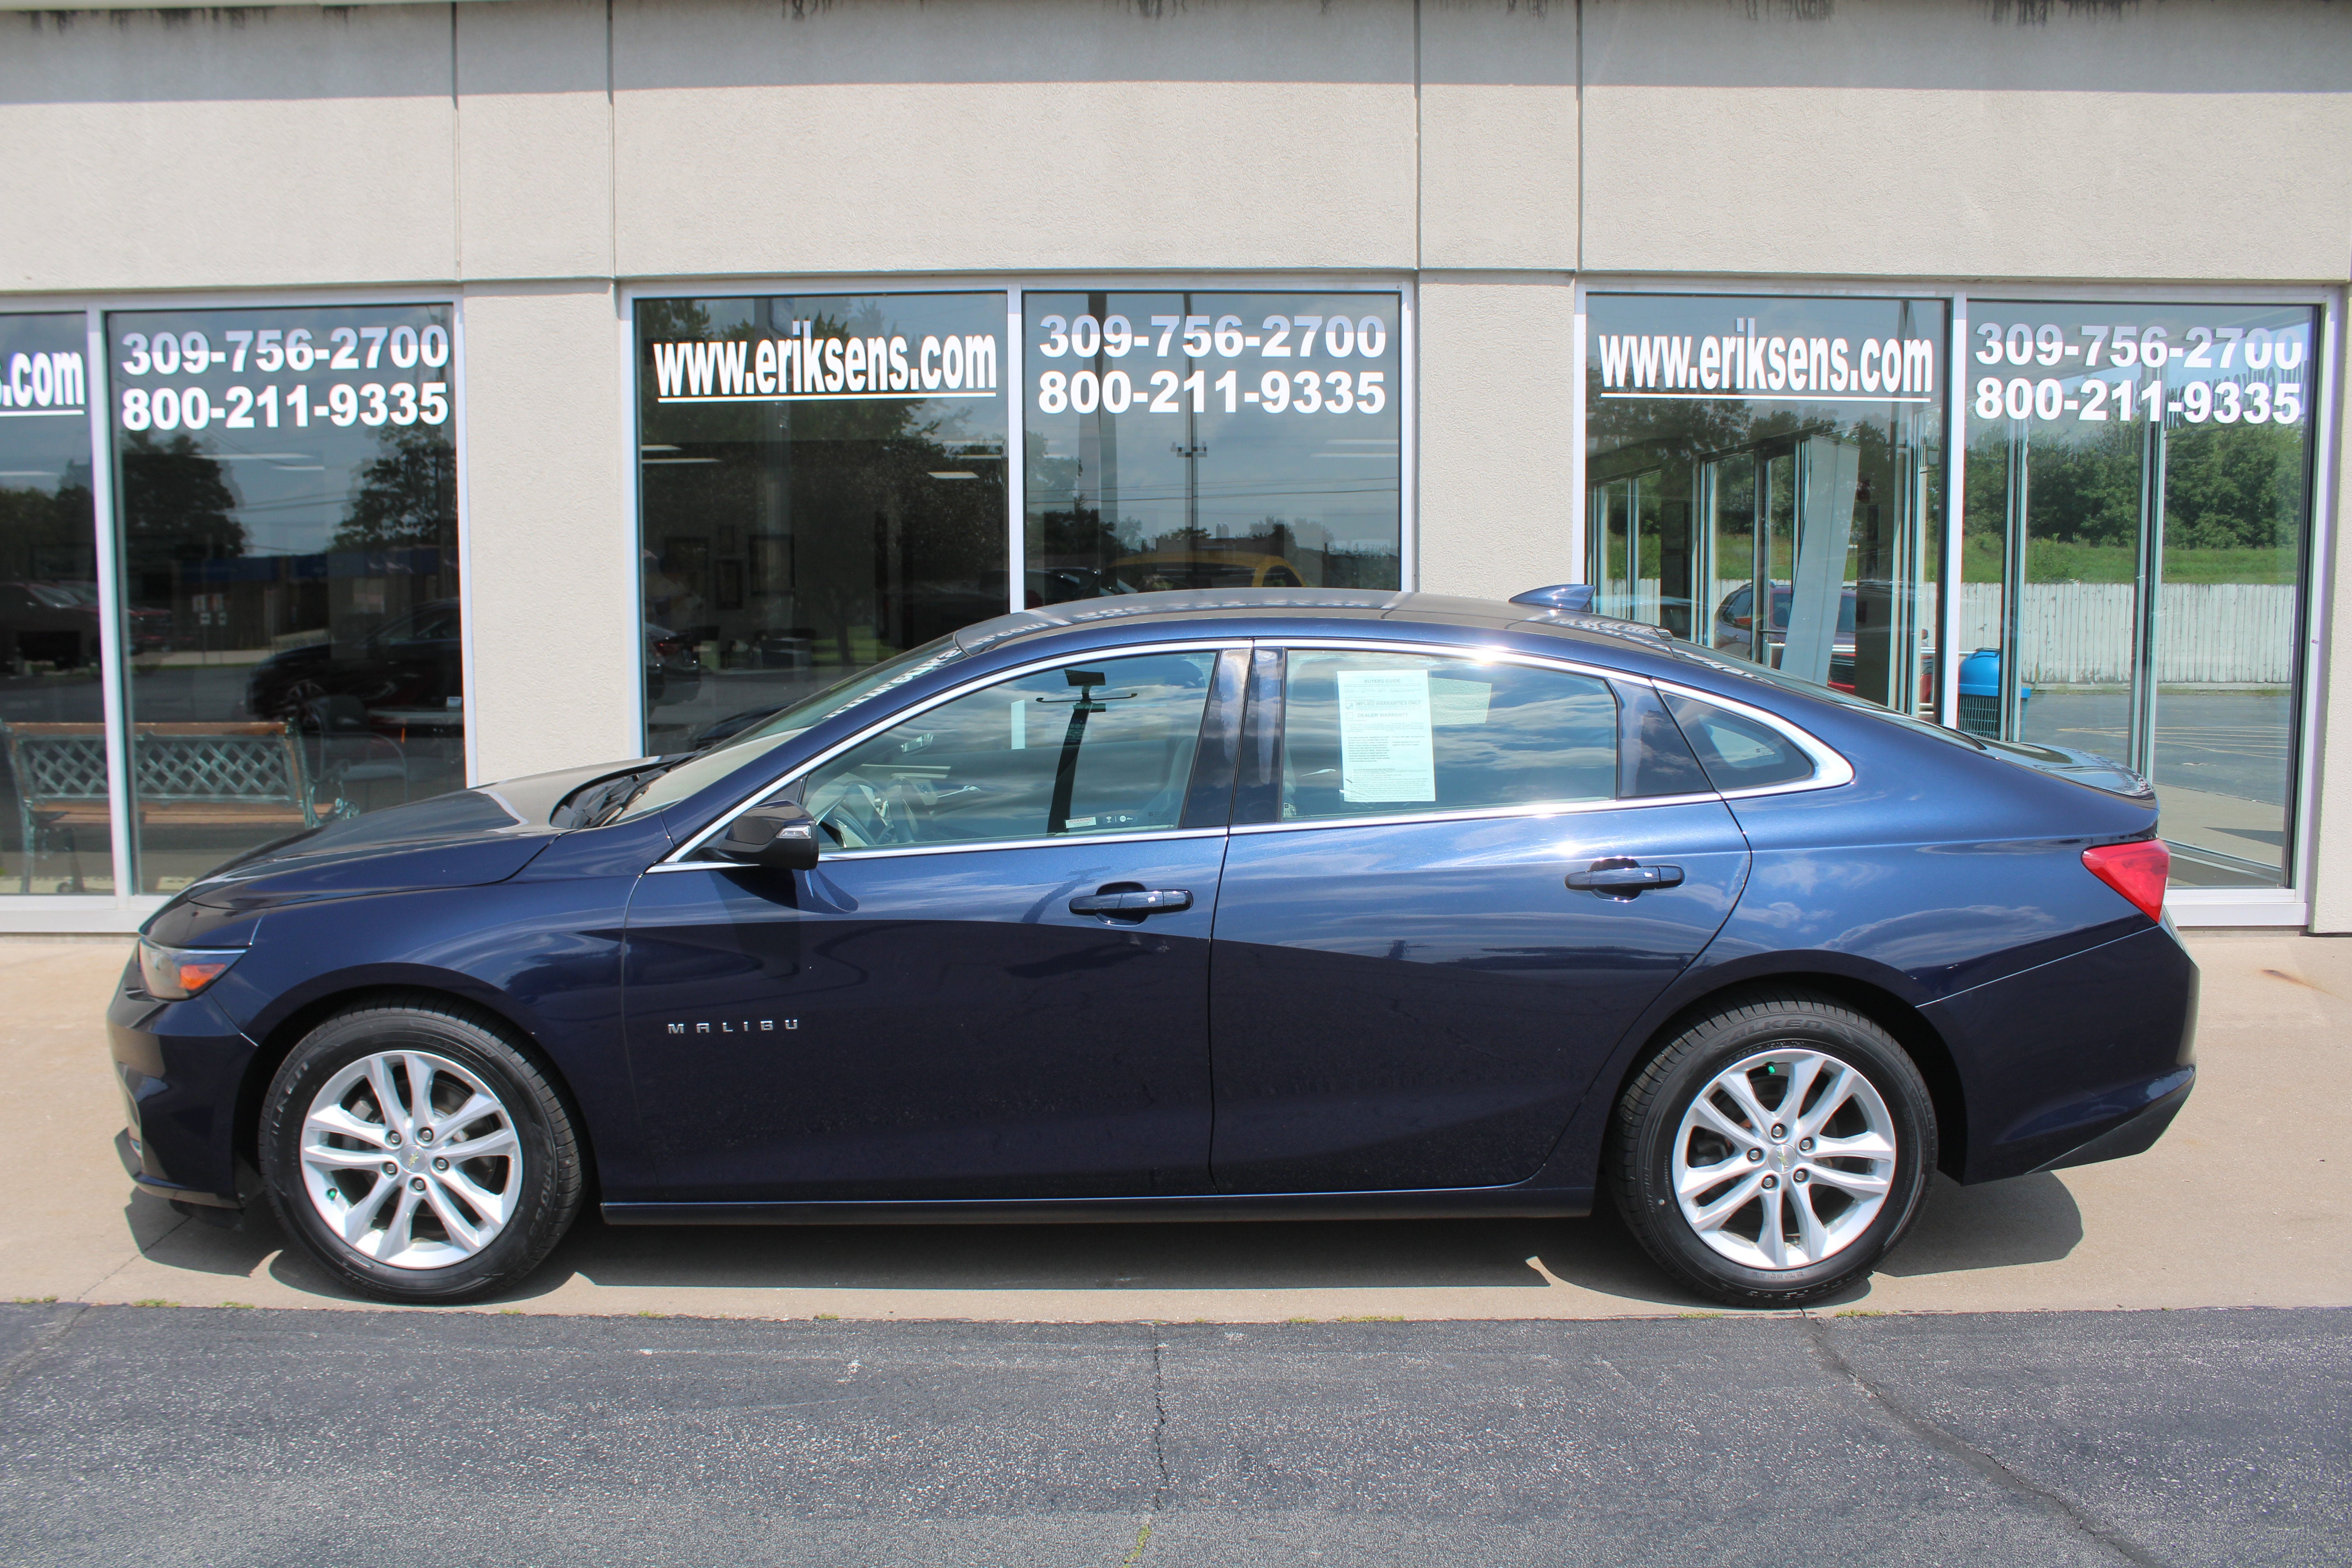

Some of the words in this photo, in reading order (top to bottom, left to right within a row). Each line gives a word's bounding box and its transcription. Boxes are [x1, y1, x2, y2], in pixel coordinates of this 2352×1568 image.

[122, 325, 450, 376] 309-756-2700
[653, 320, 997, 396] www.eriksens.com
[1039, 314, 1386, 358] 309-756-2700
[1599, 318, 1933, 393] www.eriksens.com
[1975, 323, 2302, 370] 309-756-2700
[0, 352, 85, 408] .com
[1038, 370, 1386, 414] 800-211-9335
[1975, 377, 2301, 425] 800-211-9335
[122, 382, 449, 431] 800-211-9335
[668, 1018, 798, 1034] MALIBU
